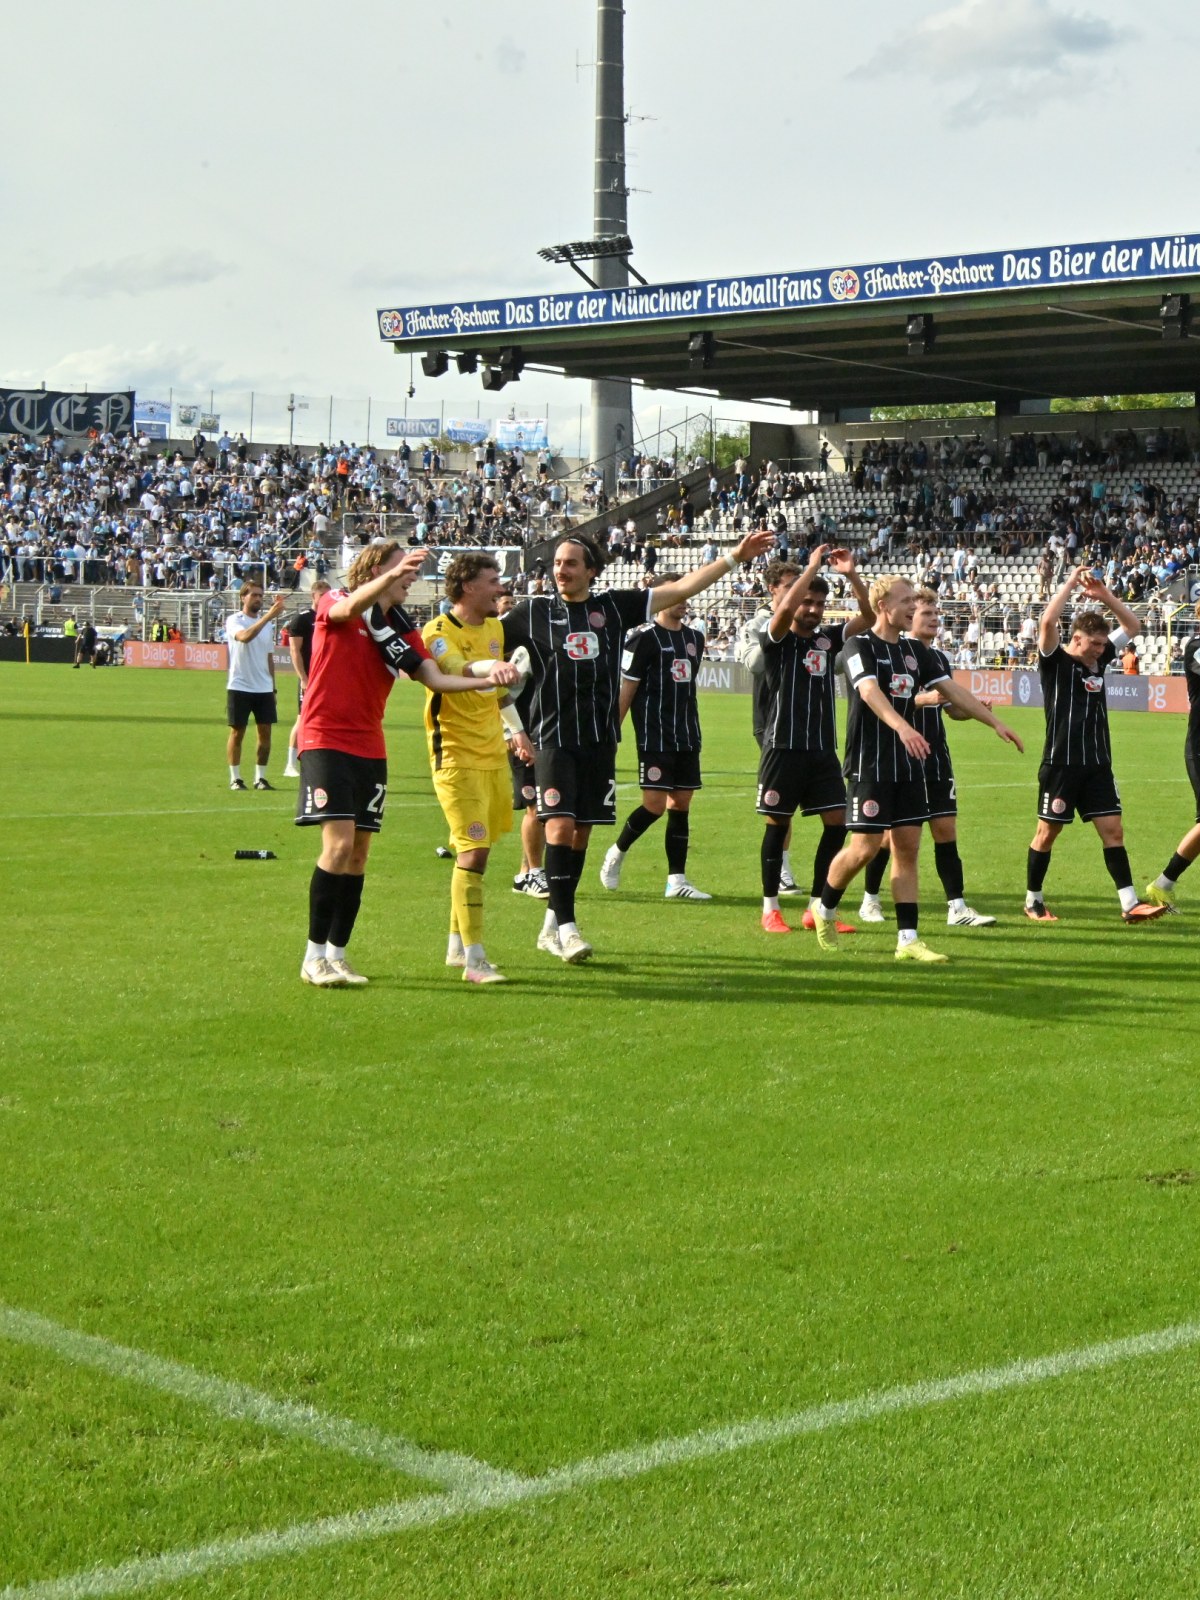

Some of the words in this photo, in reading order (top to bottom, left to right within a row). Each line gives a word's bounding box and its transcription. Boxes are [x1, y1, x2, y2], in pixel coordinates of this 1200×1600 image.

[864, 259, 995, 295] Hacker-Pschorr
[1001, 252, 1041, 283] Das
[1048, 247, 1095, 277] Bier
[1101, 242, 1144, 274] der
[506, 300, 533, 325] Das
[539, 295, 572, 321] Bier
[577, 293, 607, 318] der
[611, 286, 702, 317] Münchner
[707, 277, 821, 309] Fußballfans
[0, 391, 135, 437] TEN
[143, 643, 176, 666] Dialog
[185, 645, 218, 669] Dialog
[695, 666, 730, 689] MAN
[1107, 686, 1123, 697] 1860
